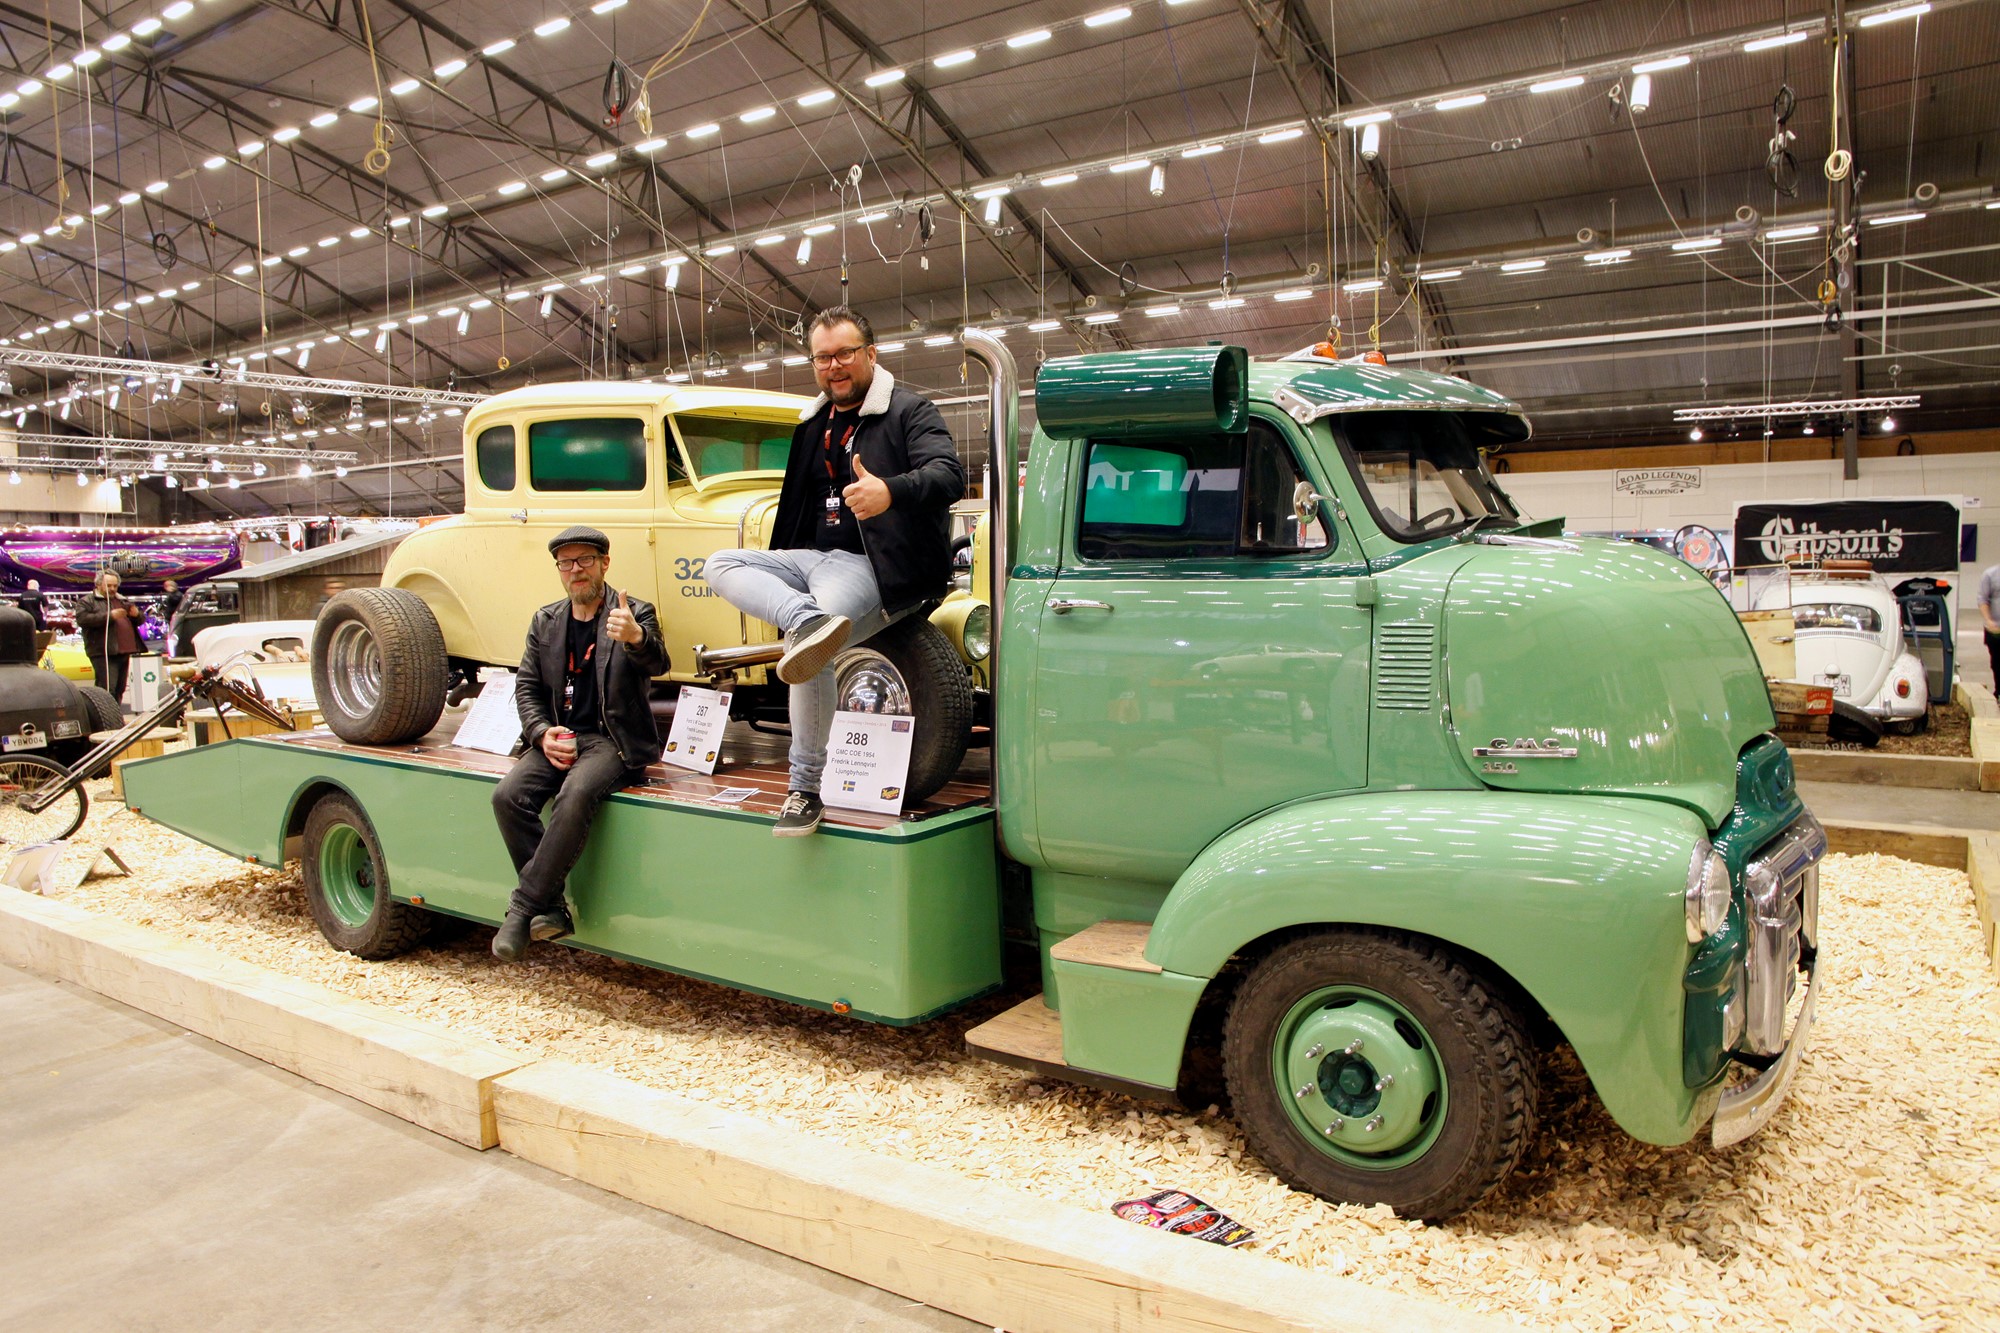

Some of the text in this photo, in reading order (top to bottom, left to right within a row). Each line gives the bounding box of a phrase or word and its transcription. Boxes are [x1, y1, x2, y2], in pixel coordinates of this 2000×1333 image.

[1620, 471, 1697, 485] ROAD LEGENDS
[1636, 488, 1679, 496] JÖNKÖPING
[1760, 517, 1904, 562] Gibson's
[674, 557, 707, 581] 32
[696, 705, 709, 717] 287
[845, 732, 868, 746] 288
[1490, 738, 1560, 749] GMC
[836, 748, 875, 759] GMC COE 1954
[831, 757, 877, 769] Fredrik Lennqvist
[1483, 761, 1516, 771] 350
[835, 767, 870, 777] Ljungbyholm
